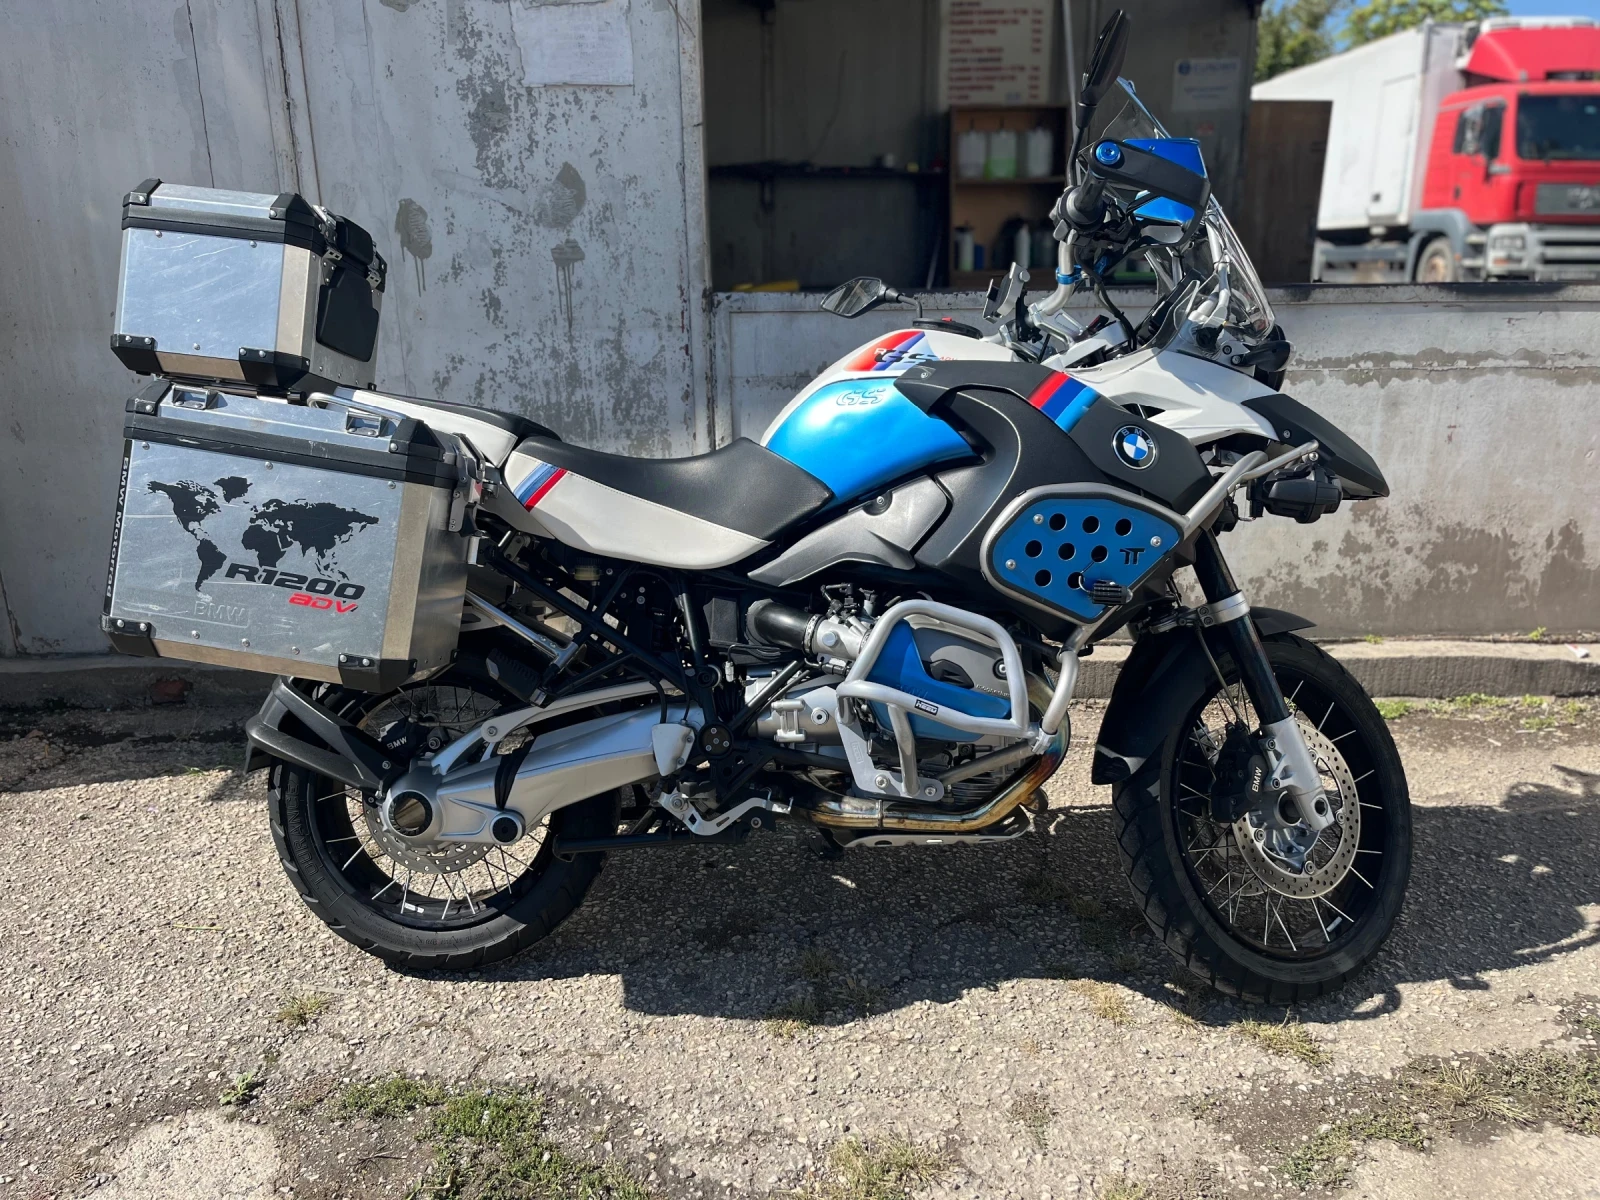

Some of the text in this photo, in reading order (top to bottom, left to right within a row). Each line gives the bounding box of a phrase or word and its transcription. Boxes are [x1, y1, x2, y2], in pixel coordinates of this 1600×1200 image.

[836, 388, 886, 406] GS
[106, 457, 129, 598] BMW Motorrad
[225, 562, 366, 600] R1200
[193, 600, 246, 622] BMW
[386, 735, 407, 750] BMW
[1251, 766, 1262, 793] BMW
